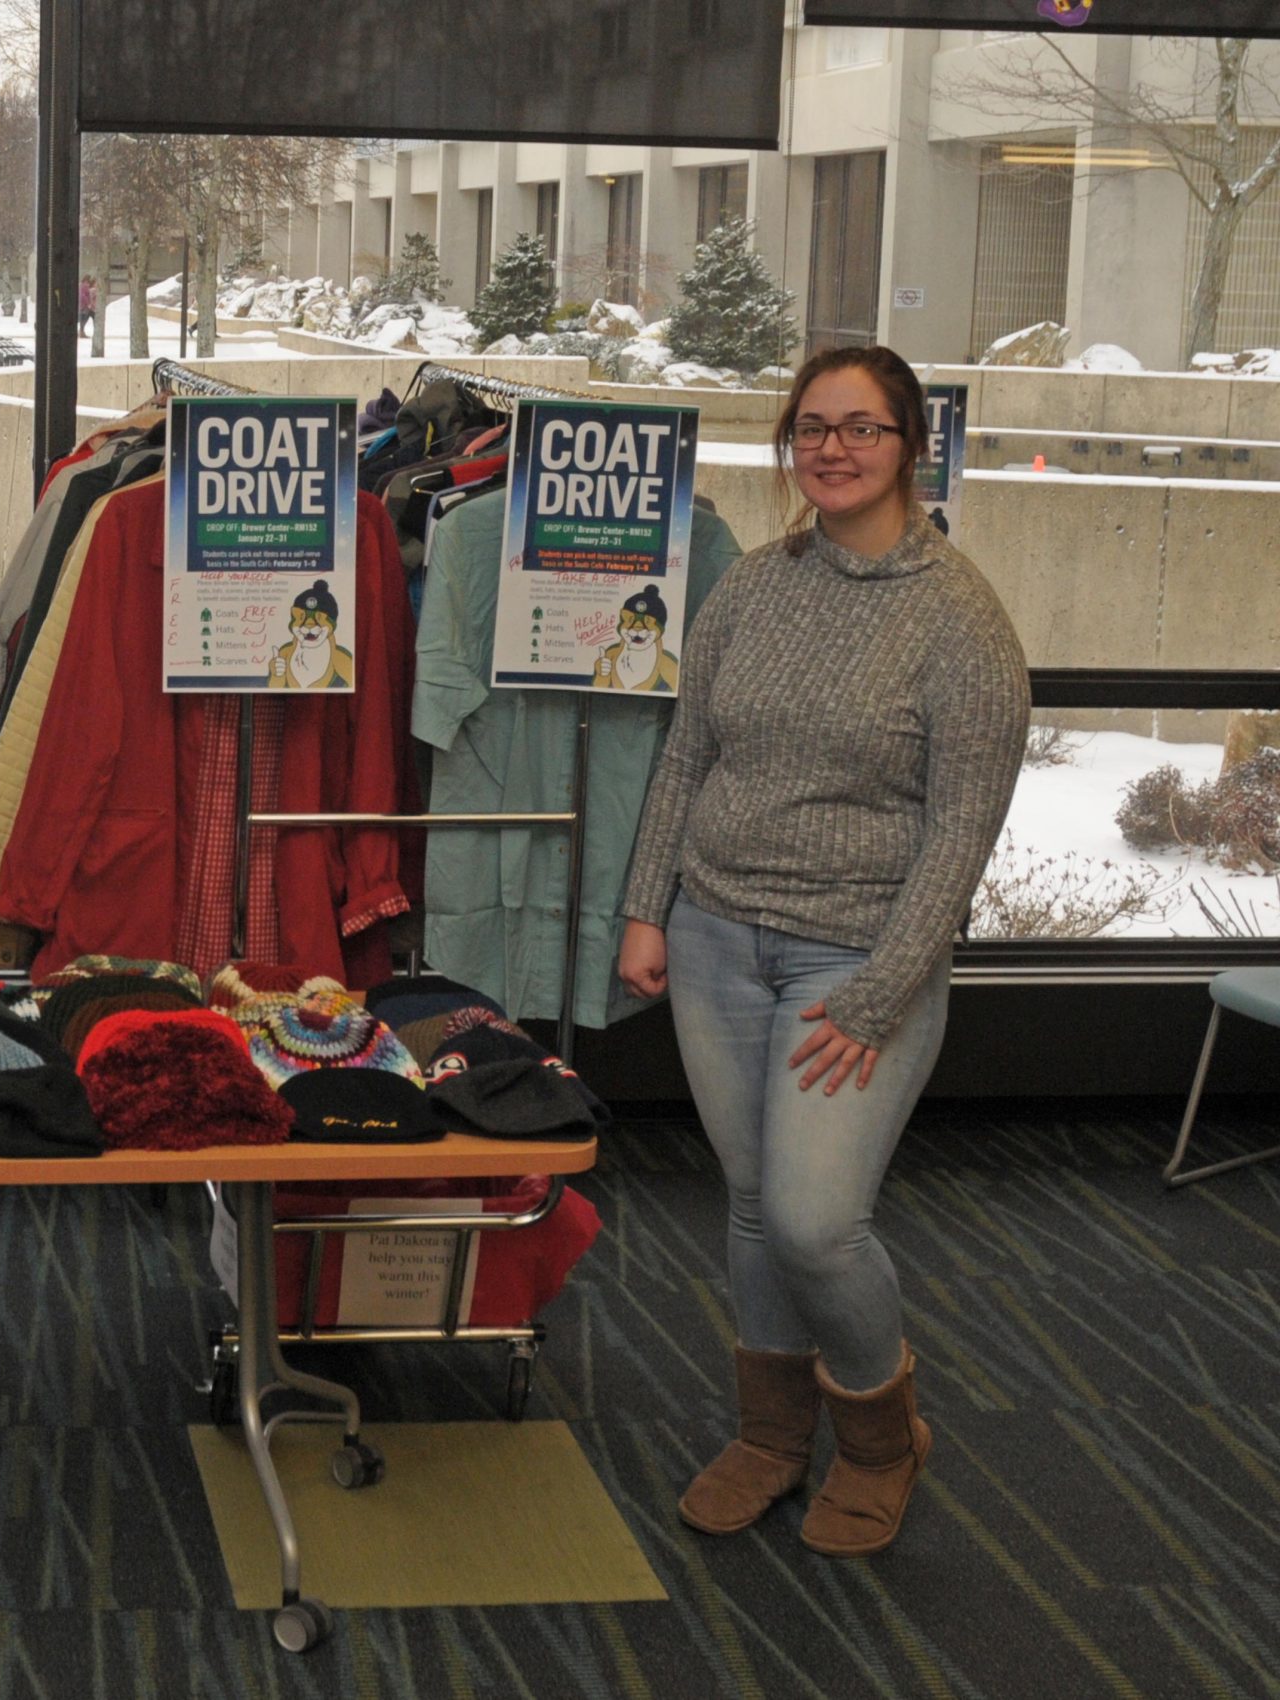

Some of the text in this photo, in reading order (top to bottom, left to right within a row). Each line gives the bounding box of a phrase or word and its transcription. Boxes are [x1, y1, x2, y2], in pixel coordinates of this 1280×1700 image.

[198, 416, 329, 468] COAT
[540, 419, 671, 474] COAT
[198, 471, 325, 514] DRIVE
[536, 472, 664, 520] DRIVE
[206, 523, 225, 532] DROP
[226, 523, 240, 532] OFF:
[242, 523, 266, 532] Brewer
[544, 524, 561, 532] DROP
[563, 524, 576, 533] OFF:
[578, 525, 601, 534] Brewer
[238, 534, 264, 544] January
[573, 536, 599, 546] January
[200, 571, 273, 581] HELP YOURSELF
[552, 571, 586, 583] TAKE
[591, 573, 599, 582] A
[215, 609, 239, 618] Coats
[243, 605, 277, 617] FREE
[546, 608, 569, 617] Coats
[574, 611, 602, 629] HELP
[215, 625, 235, 634] Hats
[545, 624, 564, 632] Hats
[215, 641, 247, 649] Mittens
[544, 639, 576, 648] Mittens
[215, 656, 248, 665] Scarves
[543, 655, 574, 664] Scarves
[393, 1234, 439, 1246] Dakota
[369, 1251, 396, 1266] help
[400, 1255, 424, 1267] you
[377, 1271, 440, 1282] warm this
